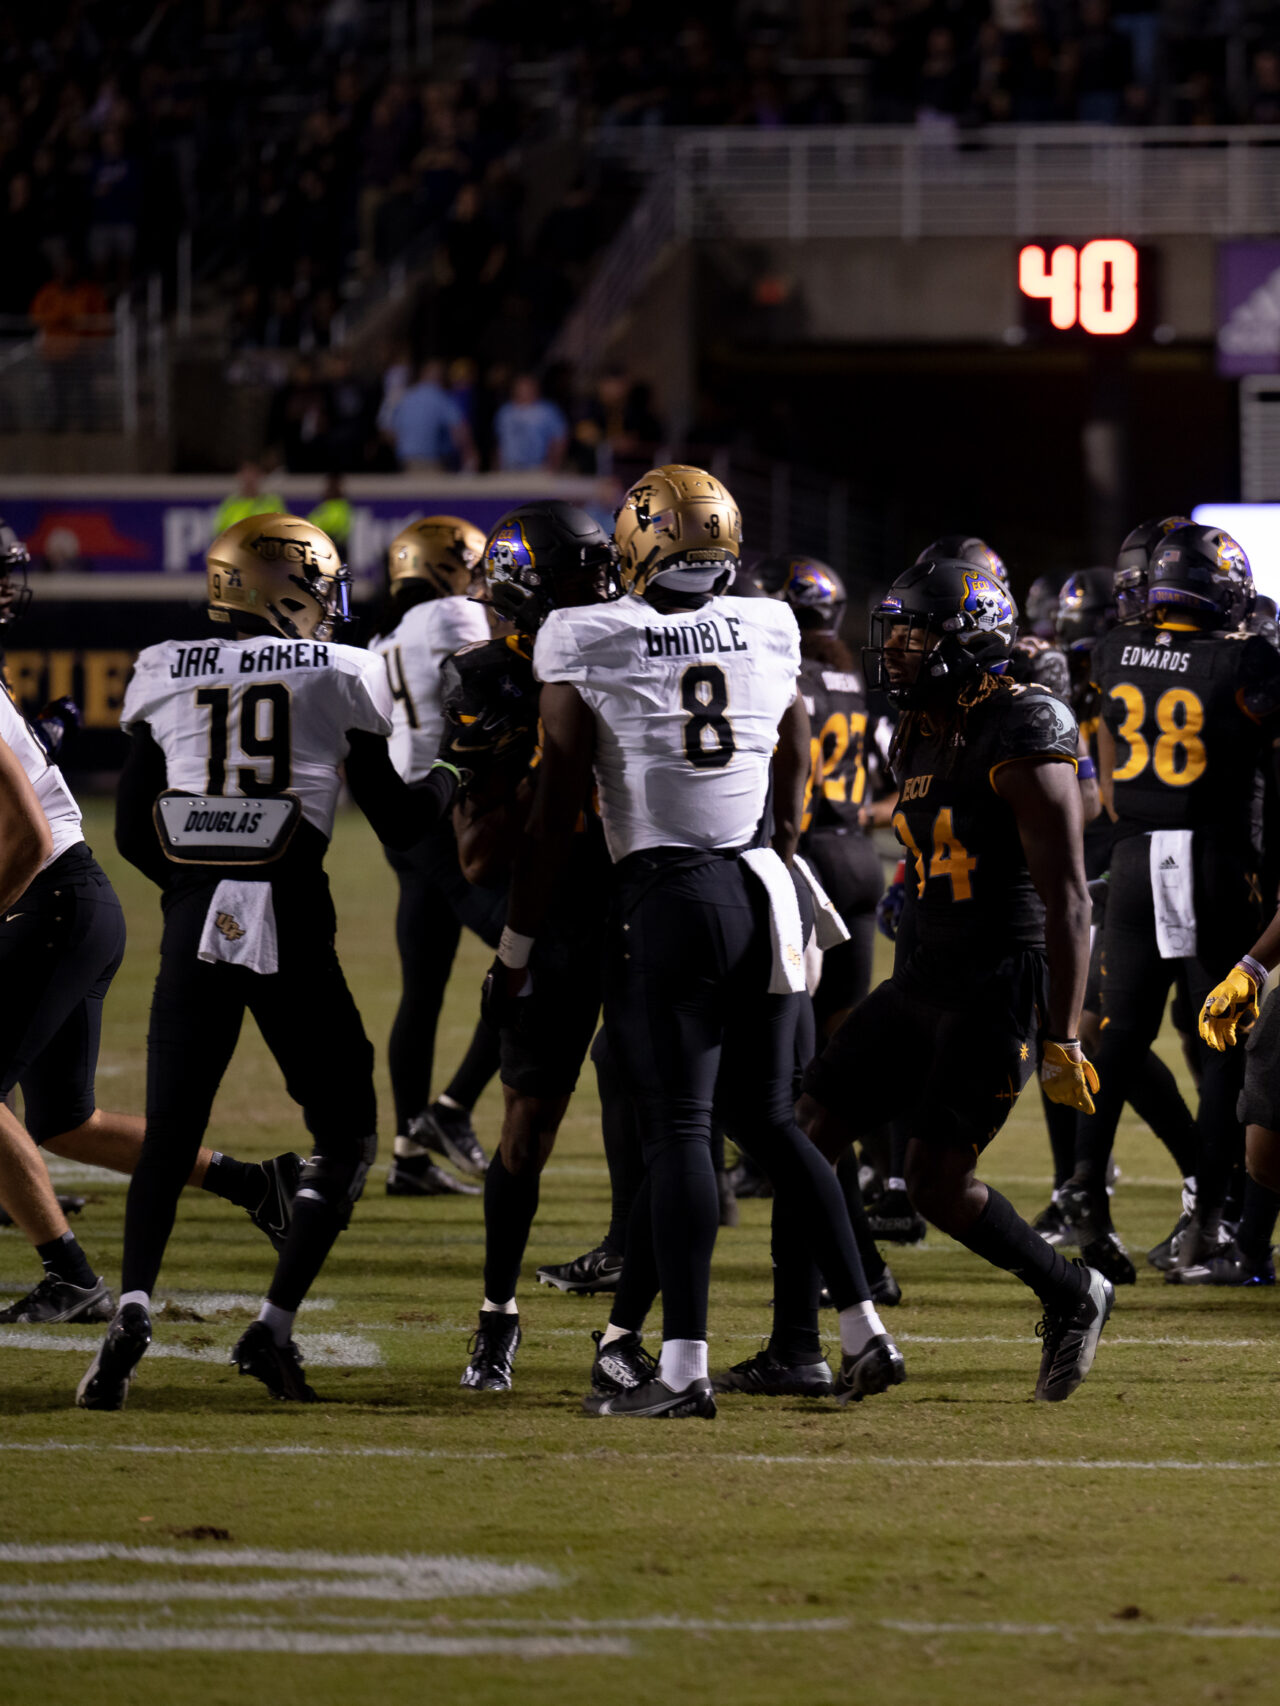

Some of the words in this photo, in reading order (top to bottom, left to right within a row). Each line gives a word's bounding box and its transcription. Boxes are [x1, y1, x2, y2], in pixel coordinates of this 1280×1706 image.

[1018, 239, 1138, 335] 40
[971, 580, 989, 592] ECU
[170, 647, 224, 679] JAR.
[239, 643, 330, 674] BAKER
[1120, 646, 1192, 673] EDWARDS
[680, 662, 737, 771] 8
[194, 680, 292, 797] 19
[1108, 682, 1208, 788] 38
[900, 773, 935, 803] ECU
[183, 811, 262, 834] DOUGLAS
